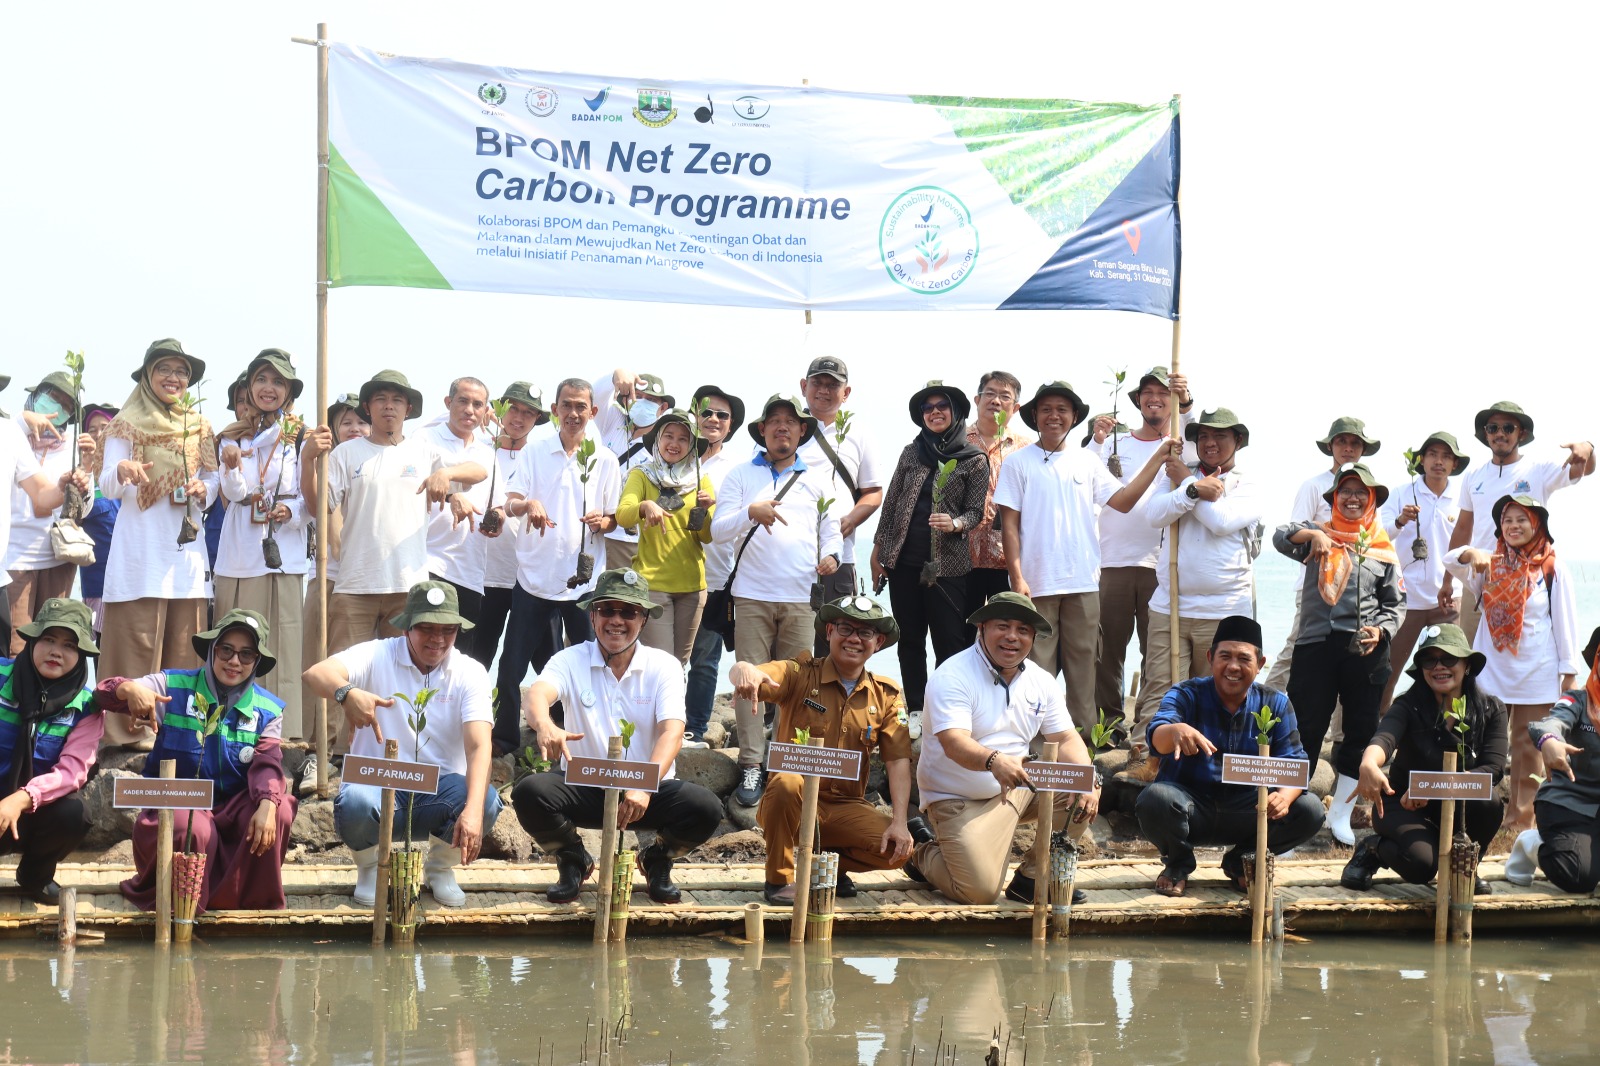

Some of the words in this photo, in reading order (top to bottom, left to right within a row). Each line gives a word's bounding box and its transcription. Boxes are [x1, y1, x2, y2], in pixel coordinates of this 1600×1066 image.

[571, 113, 601, 122] BADAN
[603, 114, 623, 122] POM
[475, 126, 591, 170] BPOM
[606, 141, 675, 174] Net
[684, 143, 772, 176] Zero
[475, 168, 616, 205] Carbon
[628, 185, 851, 226] Programme
[885, 192, 935, 238] Sustainability
[478, 214, 540, 228] Kolaborasi
[543, 217, 583, 230] BPOM
[586, 218, 609, 231] dan
[612, 220, 675, 238] Pemangku
[752, 233, 782, 245] Obat
[784, 233, 807, 245] dan
[477, 231, 532, 244] Makanan
[534, 233, 572, 246] dalam
[575, 235, 652, 251] Mewujudkan
[655, 240, 677, 252] Net
[679, 241, 706, 254] Zero
[752, 250, 763, 262] di
[766, 251, 823, 263] Indonesia
[476, 245, 521, 258] melalui
[524, 249, 568, 261] Inisiatif
[571, 250, 643, 265] Penanaman
[645, 255, 704, 270] Mangrove
[887, 249, 907, 280] BPOM
[907, 275, 925, 288] Net
[928, 279, 951, 289] Zero
[951, 248, 974, 281] Carbon
[1092, 259, 1117, 269] Taman
[1117, 260, 1141, 272] Segara
[1089, 269, 1105, 279] Kab.
[1107, 270, 1133, 282] Serang,
[1133, 272, 1141, 281] 31
[1142, 273, 1161, 284] Oktober
[770, 745, 790, 753] DINAS
[791, 748, 836, 758] LINGKUNGAN
[837, 752, 859, 760] HIDUP
[783, 754, 799, 762] DAN
[799, 756, 842, 767] KEHUTANAN
[1230, 757, 1251, 765] DINAS
[1251, 759, 1286, 768] KELAUTAN
[359, 766, 375, 776] GP
[377, 768, 425, 782] FARMASI
[581, 766, 597, 776] GP
[598, 768, 645, 780] FARMASI
[781, 762, 813, 772] PROVINSI
[814, 766, 842, 775] BANTEN
[1024, 767, 1041, 775] PALA
[1042, 768, 1061, 776] BALAI
[1062, 770, 1084, 778] BESAR
[1231, 766, 1268, 774] PERIKANAN
[1269, 769, 1299, 777] PROVINSI
[1047, 776, 1074, 784] SERANG
[1251, 775, 1278, 783] BANTEN
[1418, 781, 1430, 789] GP
[1452, 782, 1482, 790] BANTEN
